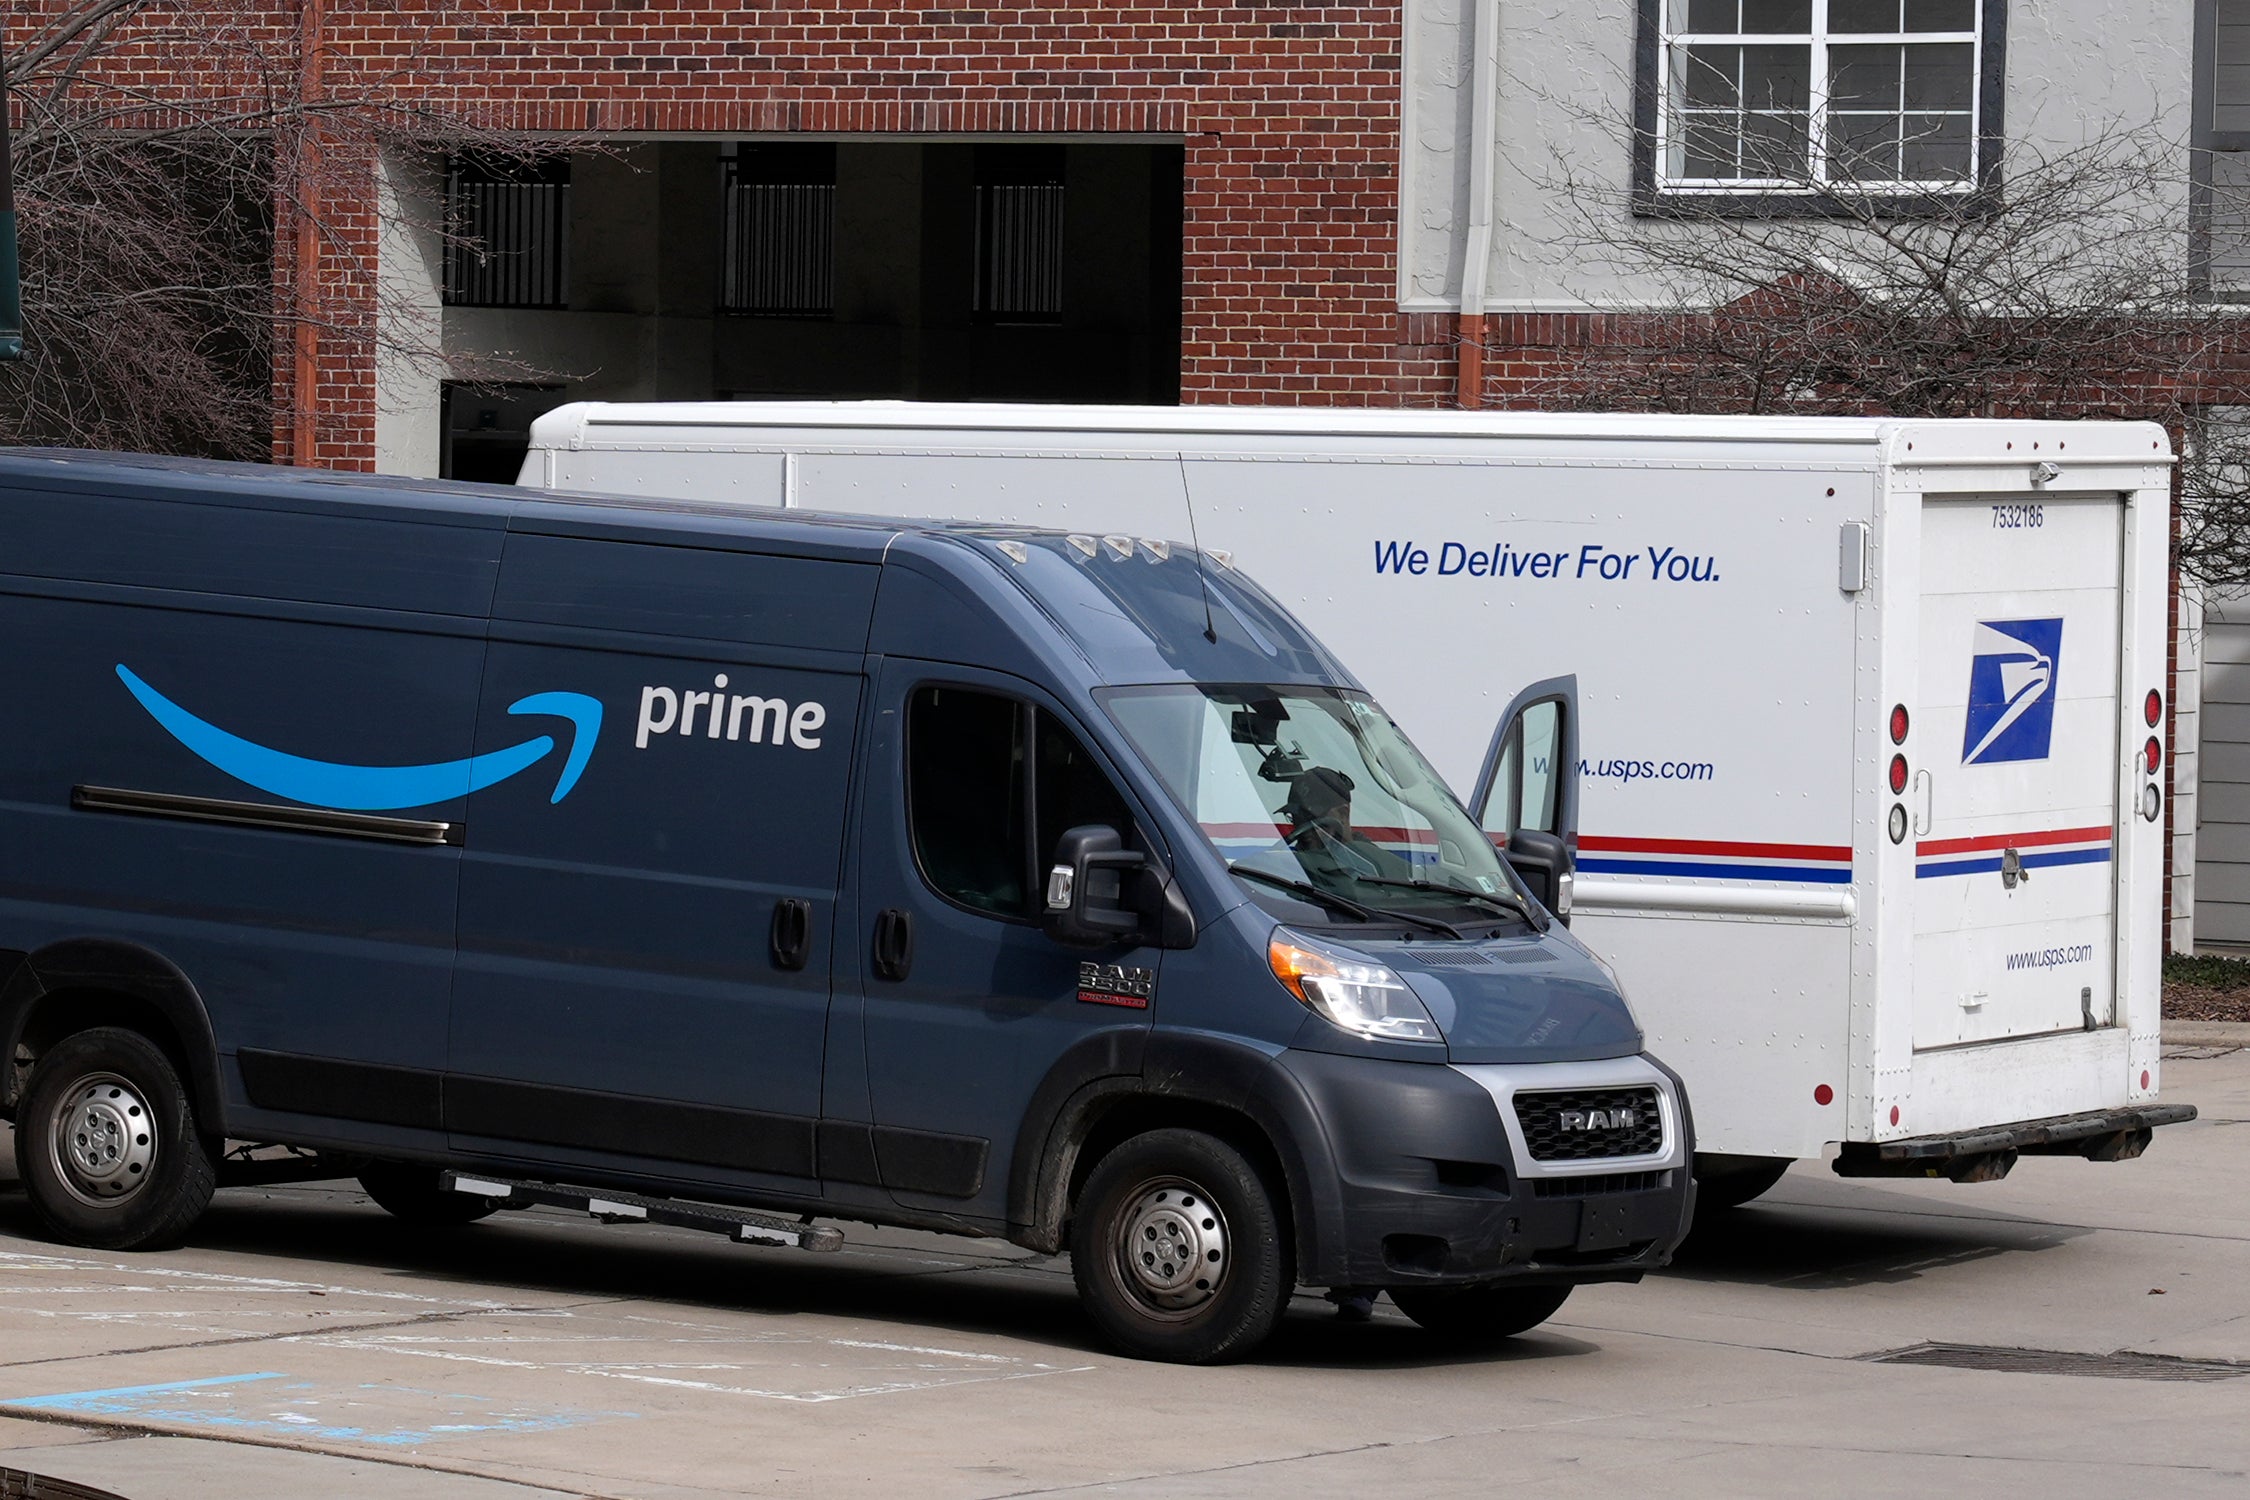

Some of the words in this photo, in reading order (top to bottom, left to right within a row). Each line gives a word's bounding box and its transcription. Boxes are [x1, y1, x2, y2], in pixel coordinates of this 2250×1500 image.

[1992, 504, 2043, 528] 7532186
[1375, 540, 1428, 575] We
[1437, 542, 1568, 578] Deliver
[1576, 545, 1639, 580] For
[1648, 546, 1720, 582] You.
[635, 673, 826, 750] prime
[2006, 944, 2092, 971] www.usps.com
[1079, 961, 1153, 982] RAM
[1078, 974, 1151, 995] 3500
[1560, 1110, 1634, 1131] RAM
